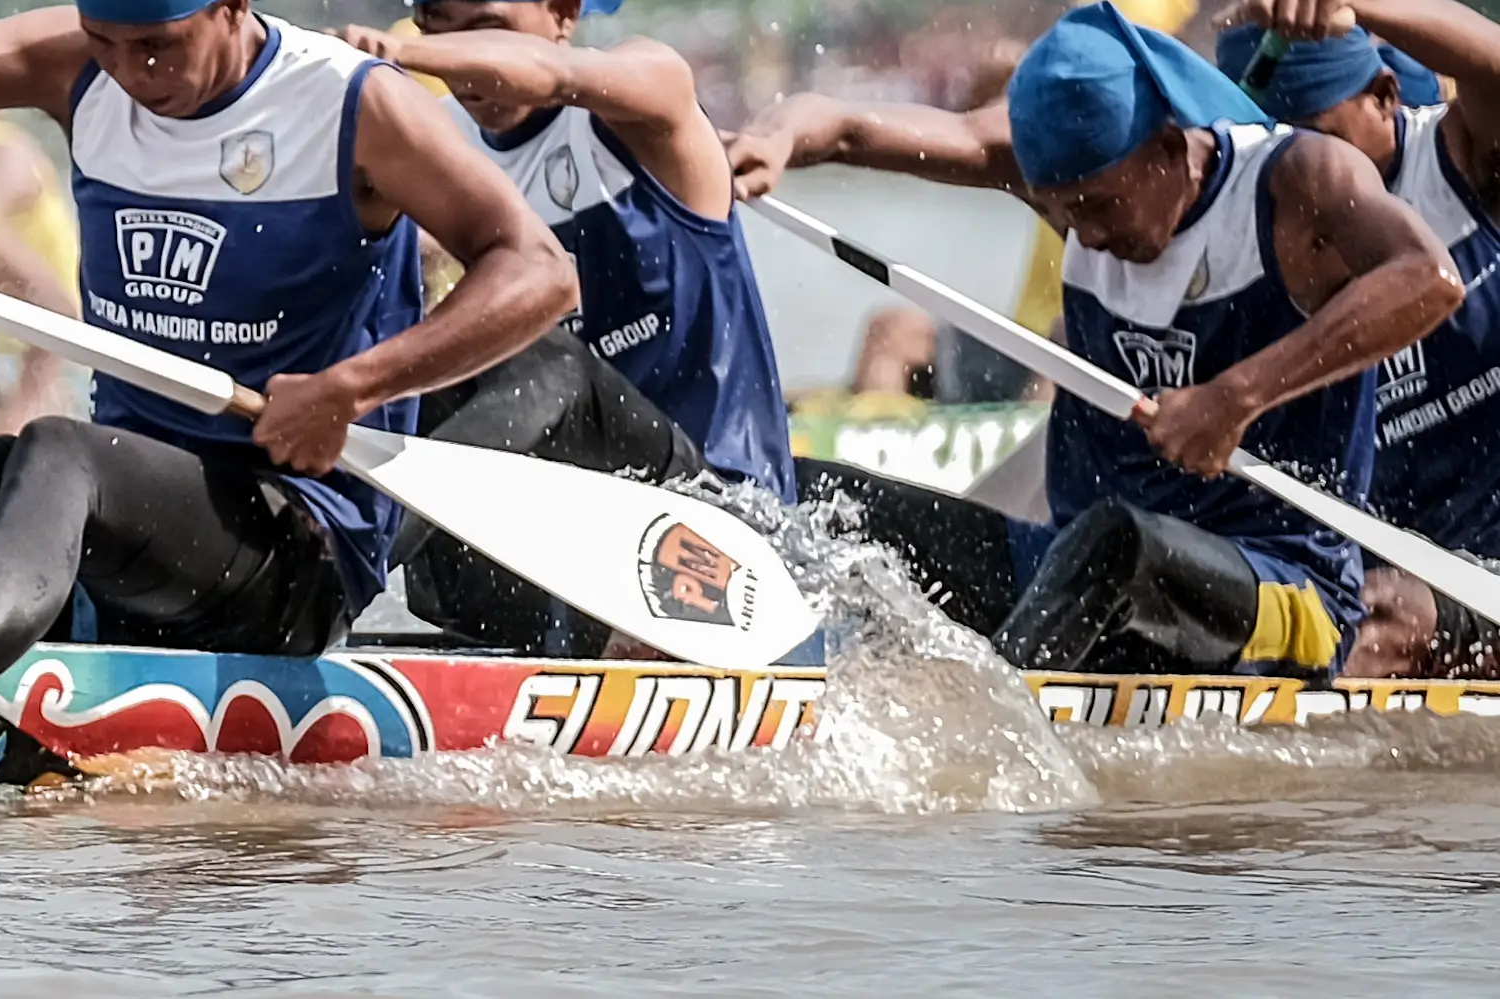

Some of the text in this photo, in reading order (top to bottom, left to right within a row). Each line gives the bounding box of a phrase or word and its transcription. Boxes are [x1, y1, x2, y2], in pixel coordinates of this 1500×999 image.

[124, 281, 204, 306] GROUP
[130, 308, 206, 343] MANDIRI
[210, 319, 279, 345] GROUP
[599, 312, 660, 358] GROUP
